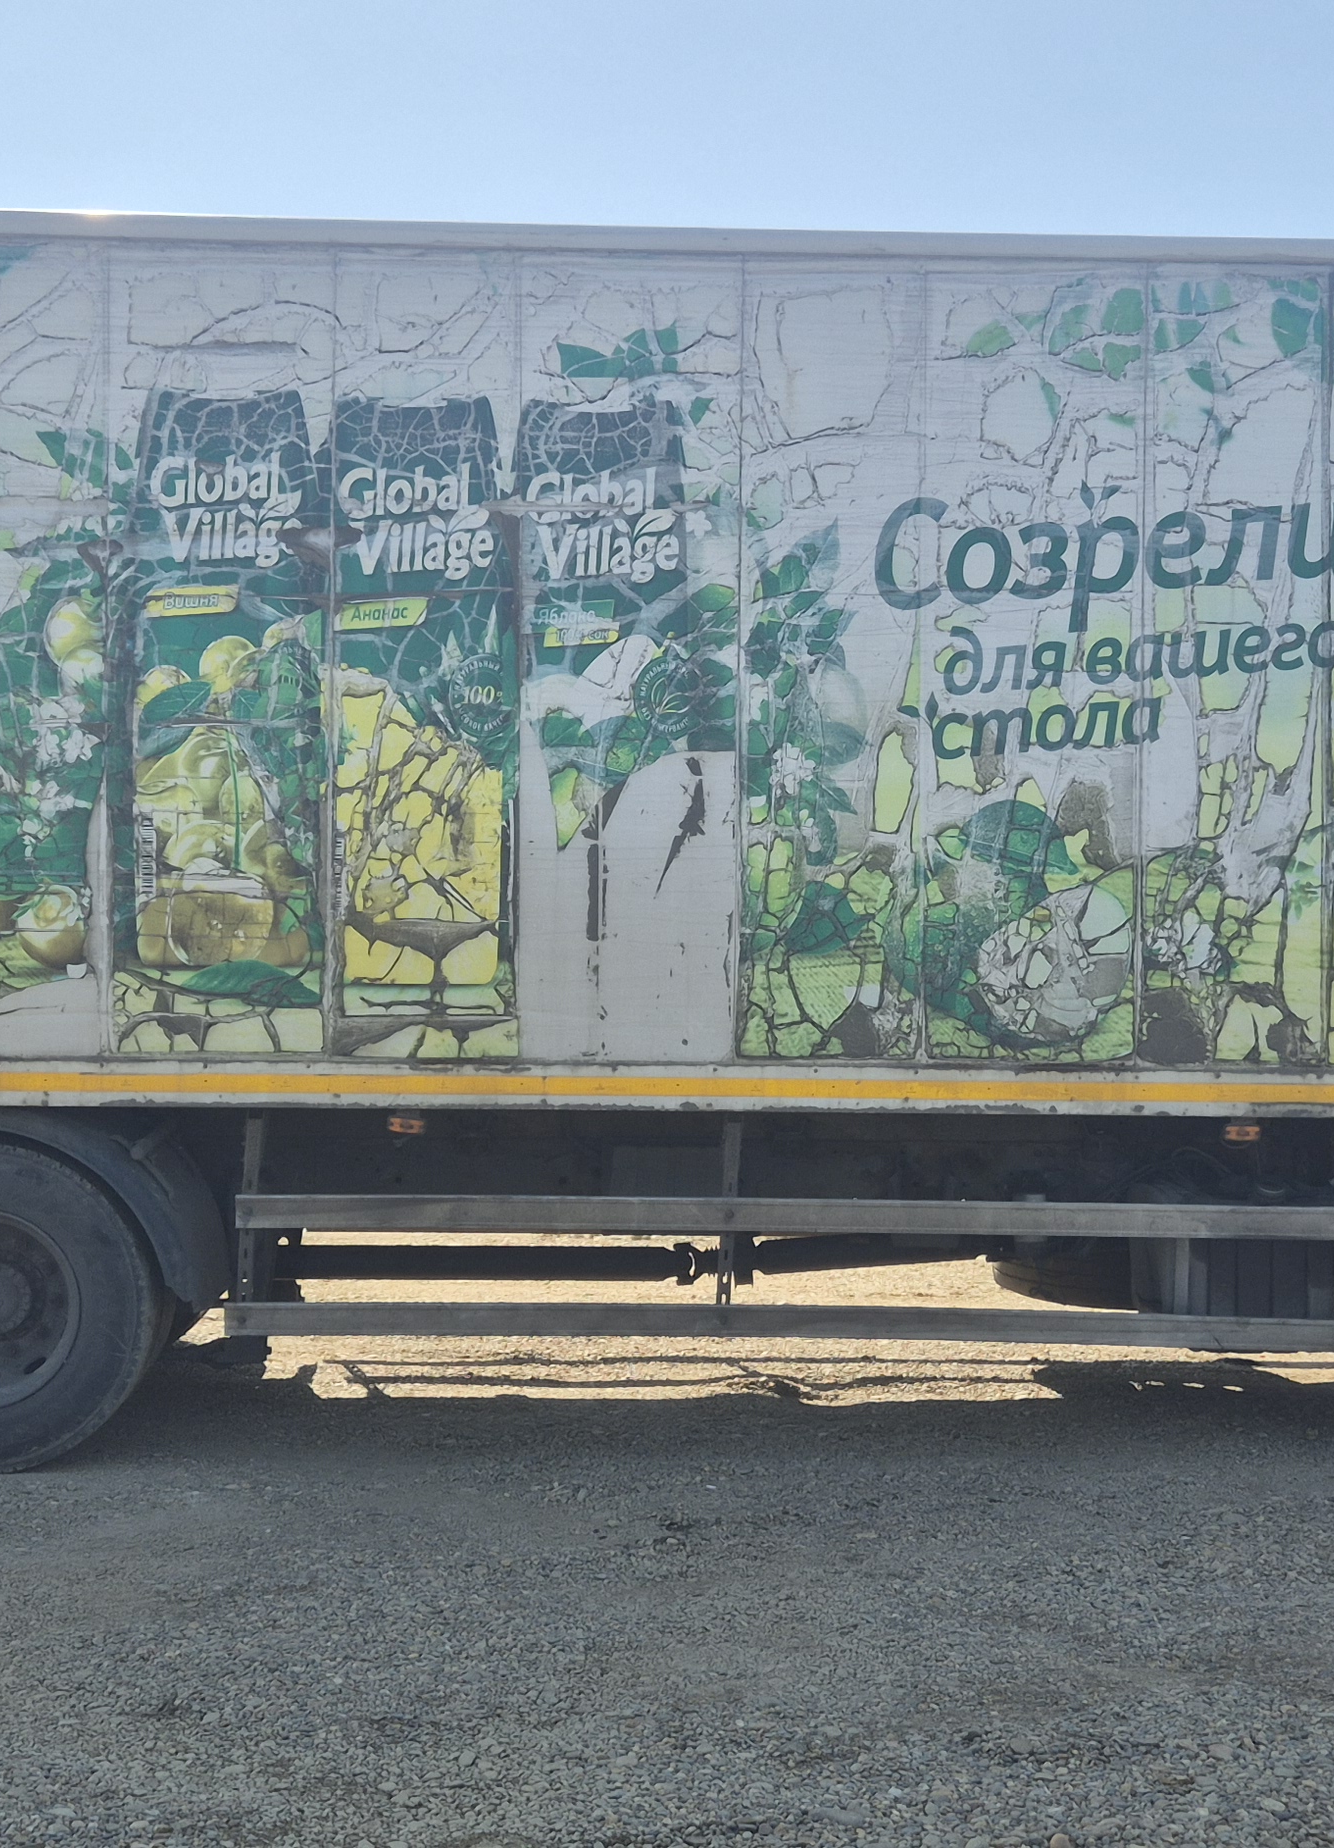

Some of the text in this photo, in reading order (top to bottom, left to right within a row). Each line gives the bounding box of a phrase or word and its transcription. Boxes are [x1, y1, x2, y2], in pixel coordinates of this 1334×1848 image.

[150, 451, 282, 508] Global
[338, 462, 471, 519] Global
[526, 466, 657, 524] Global
[348, 519, 495, 580] Village
[536, 523, 680, 583] Village
[162, 592, 219, 611] Вишня
[350, 605, 409, 622] Ананас
[537, 607, 596, 625] Яблоко
[943, 626, 1067, 695] для
[930, 697, 1162, 760] стола
